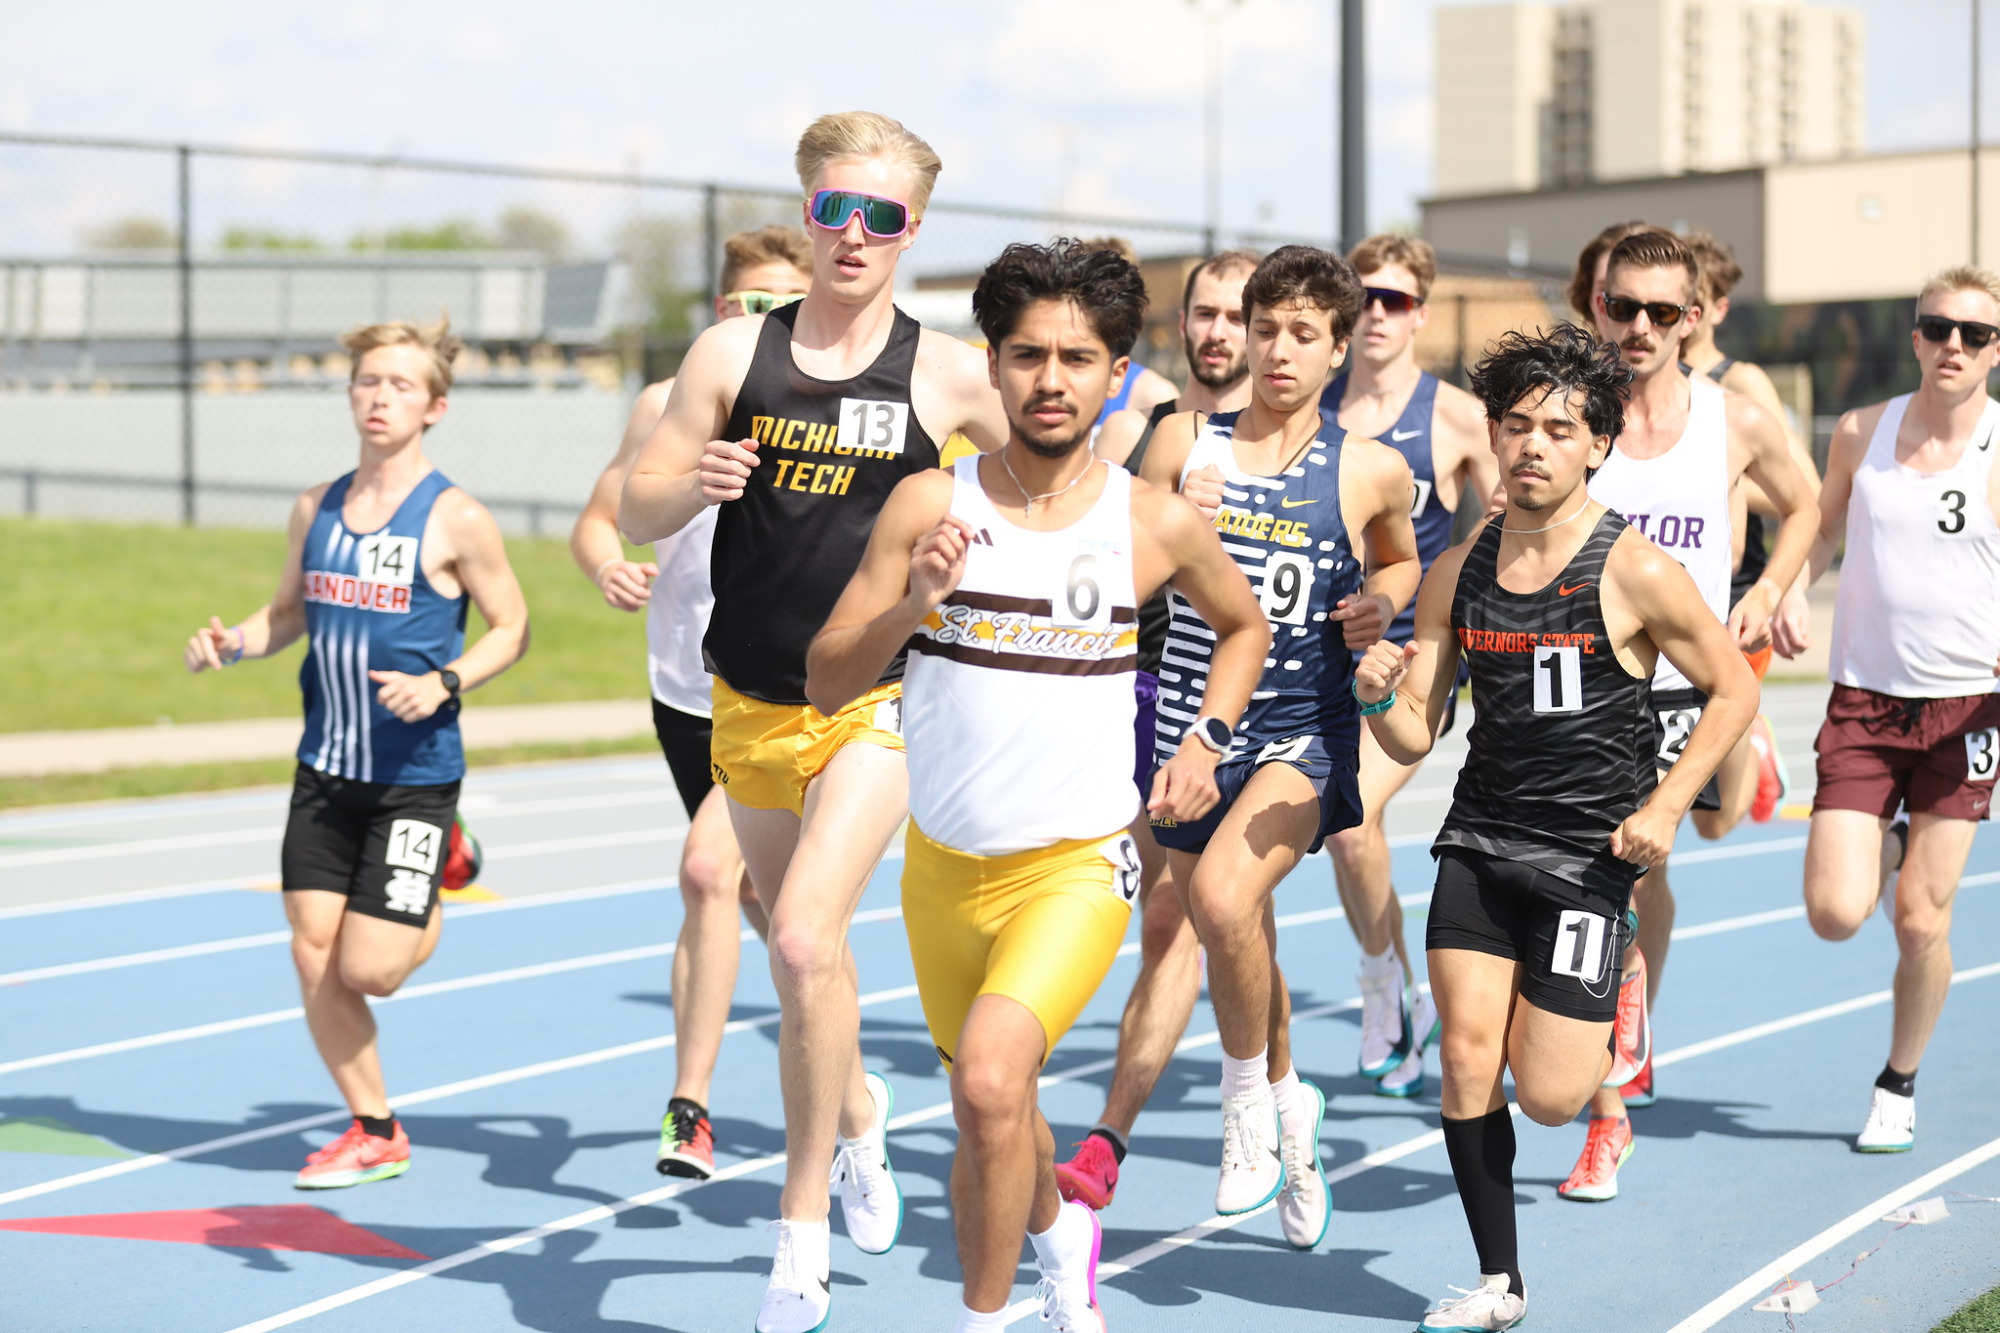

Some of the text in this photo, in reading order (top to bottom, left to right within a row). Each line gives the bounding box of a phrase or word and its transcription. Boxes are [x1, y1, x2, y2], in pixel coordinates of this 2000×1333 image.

[752, 416, 898, 461] MICHI
[852, 403, 896, 449] 13
[773, 459, 856, 496] TECH
[1212, 509, 1309, 548] AIDERS
[1937, 490, 1967, 534] 3
[367, 542, 405, 577] 14
[1066, 554, 1100, 621] 6
[1269, 562, 1302, 618] 9
[935, 604, 1120, 661] St. Francis
[1540, 652, 1564, 708] 1
[1666, 712, 1695, 754] 2
[1970, 729, 1994, 775] 3
[397, 827, 431, 865] 14
[1565, 917, 1590, 973] 1
